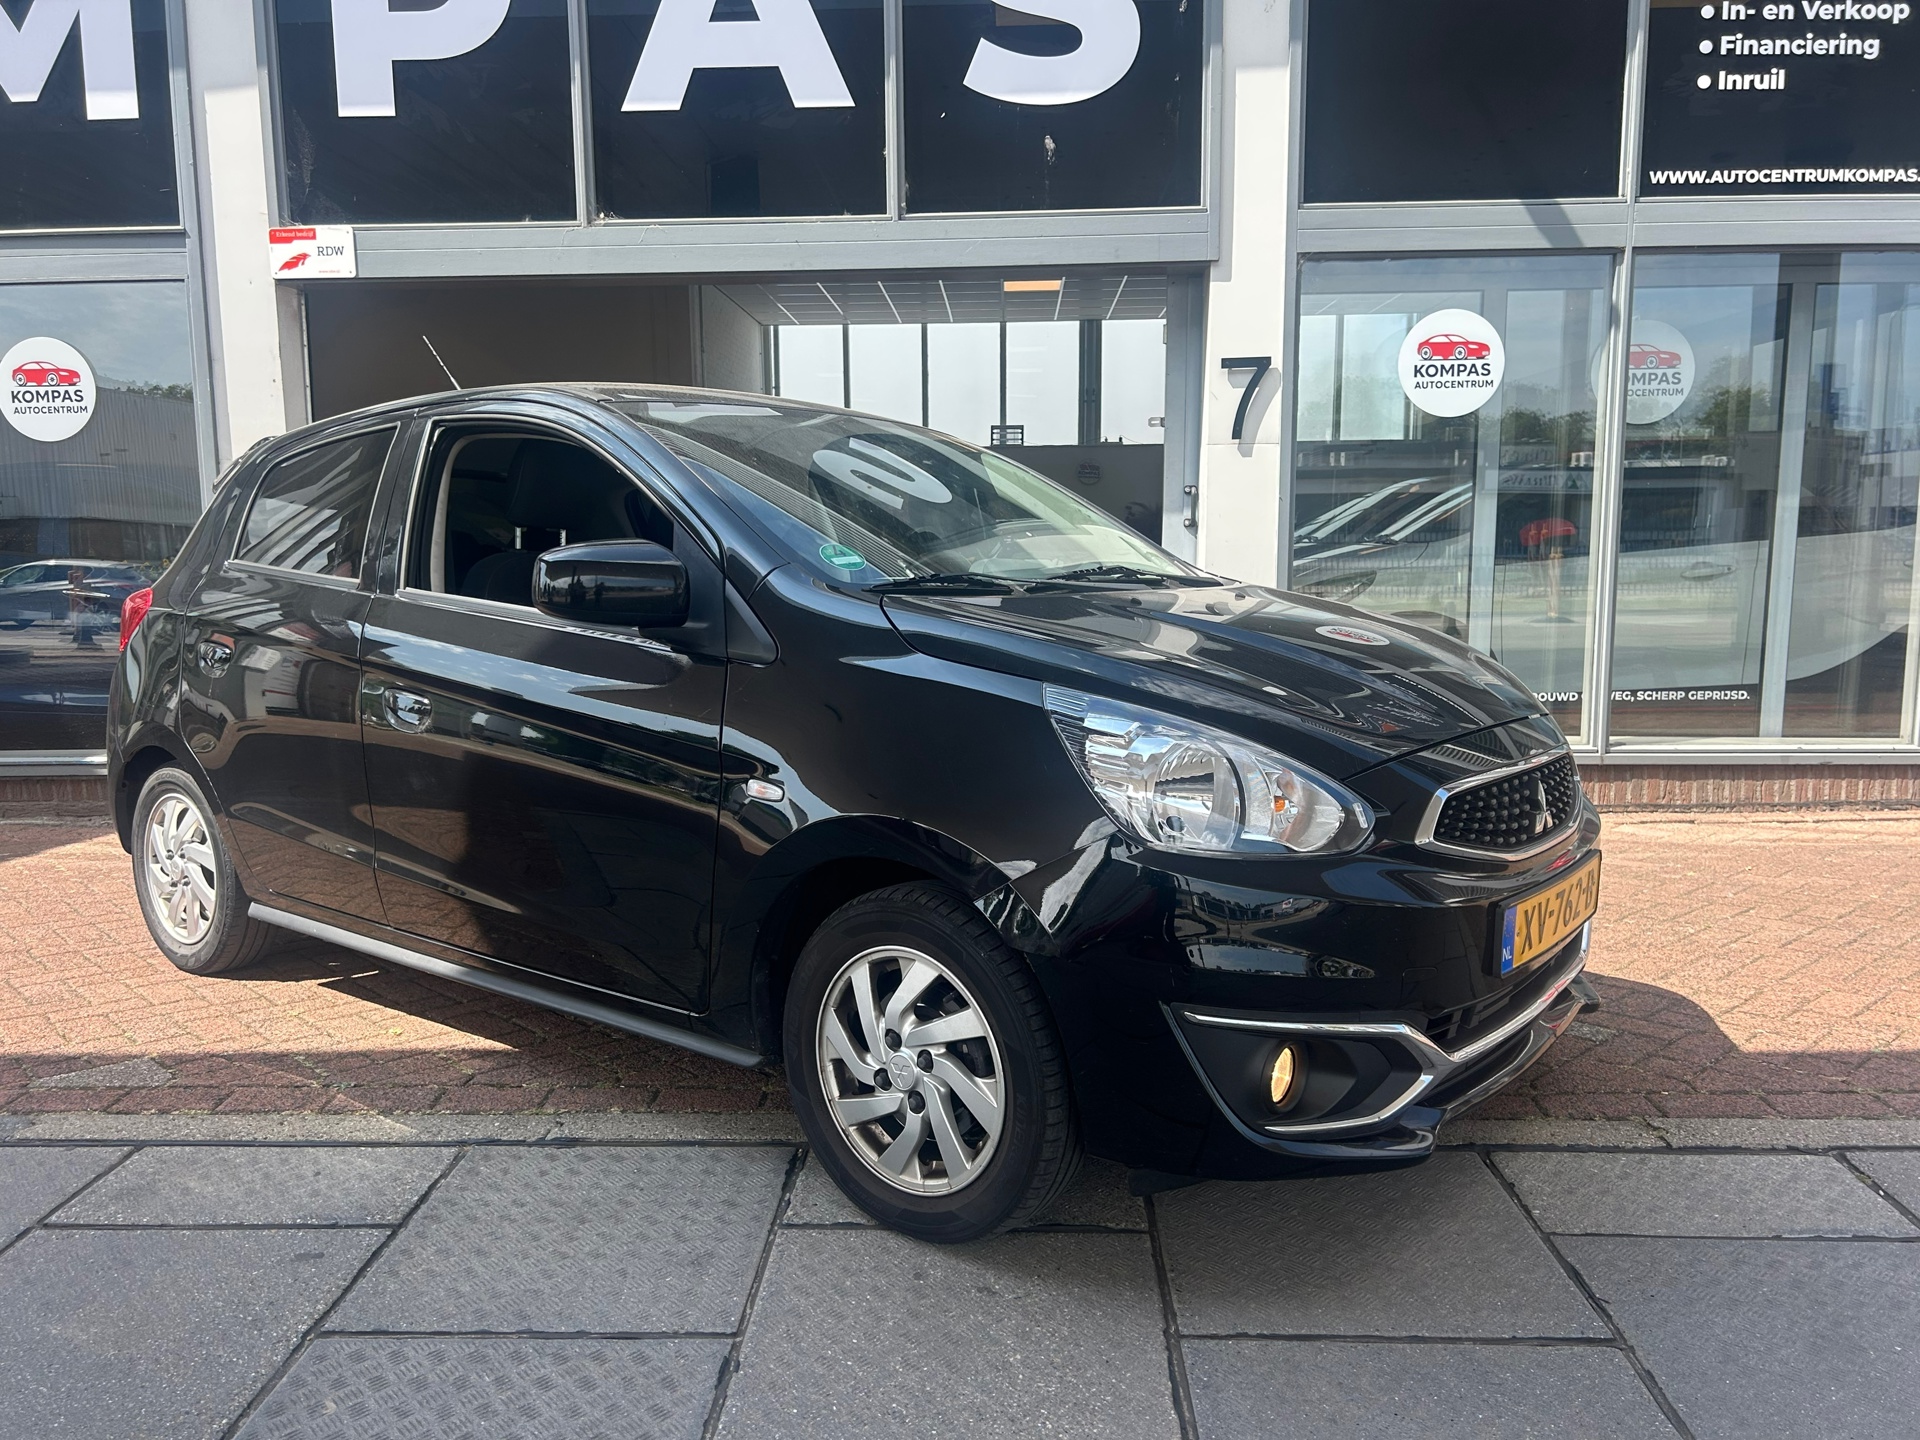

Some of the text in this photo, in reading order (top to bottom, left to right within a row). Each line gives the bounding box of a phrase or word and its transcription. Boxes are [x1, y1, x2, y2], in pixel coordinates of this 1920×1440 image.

[1721, 0, 1910, 24] In- en Verkoop
[1720, 33, 1880, 60] Financiering
[1718, 68, 1786, 90] Inruil
[317, 246, 344, 256] RDW
[1413, 363, 1491, 378] KOMPAS
[1414, 379, 1494, 389] AUTOCENTRUM
[1628, 371, 1682, 386] MPAS
[11, 389, 84, 403] KOMPAS
[1221, 356, 1271, 440] 7
[13, 406, 88, 414] AUTOCENTRUM
[1636, 690, 1685, 701] SCHERP
[1688, 690, 1751, 700] GEPRIJSD.
[1502, 945, 1513, 962] NL
